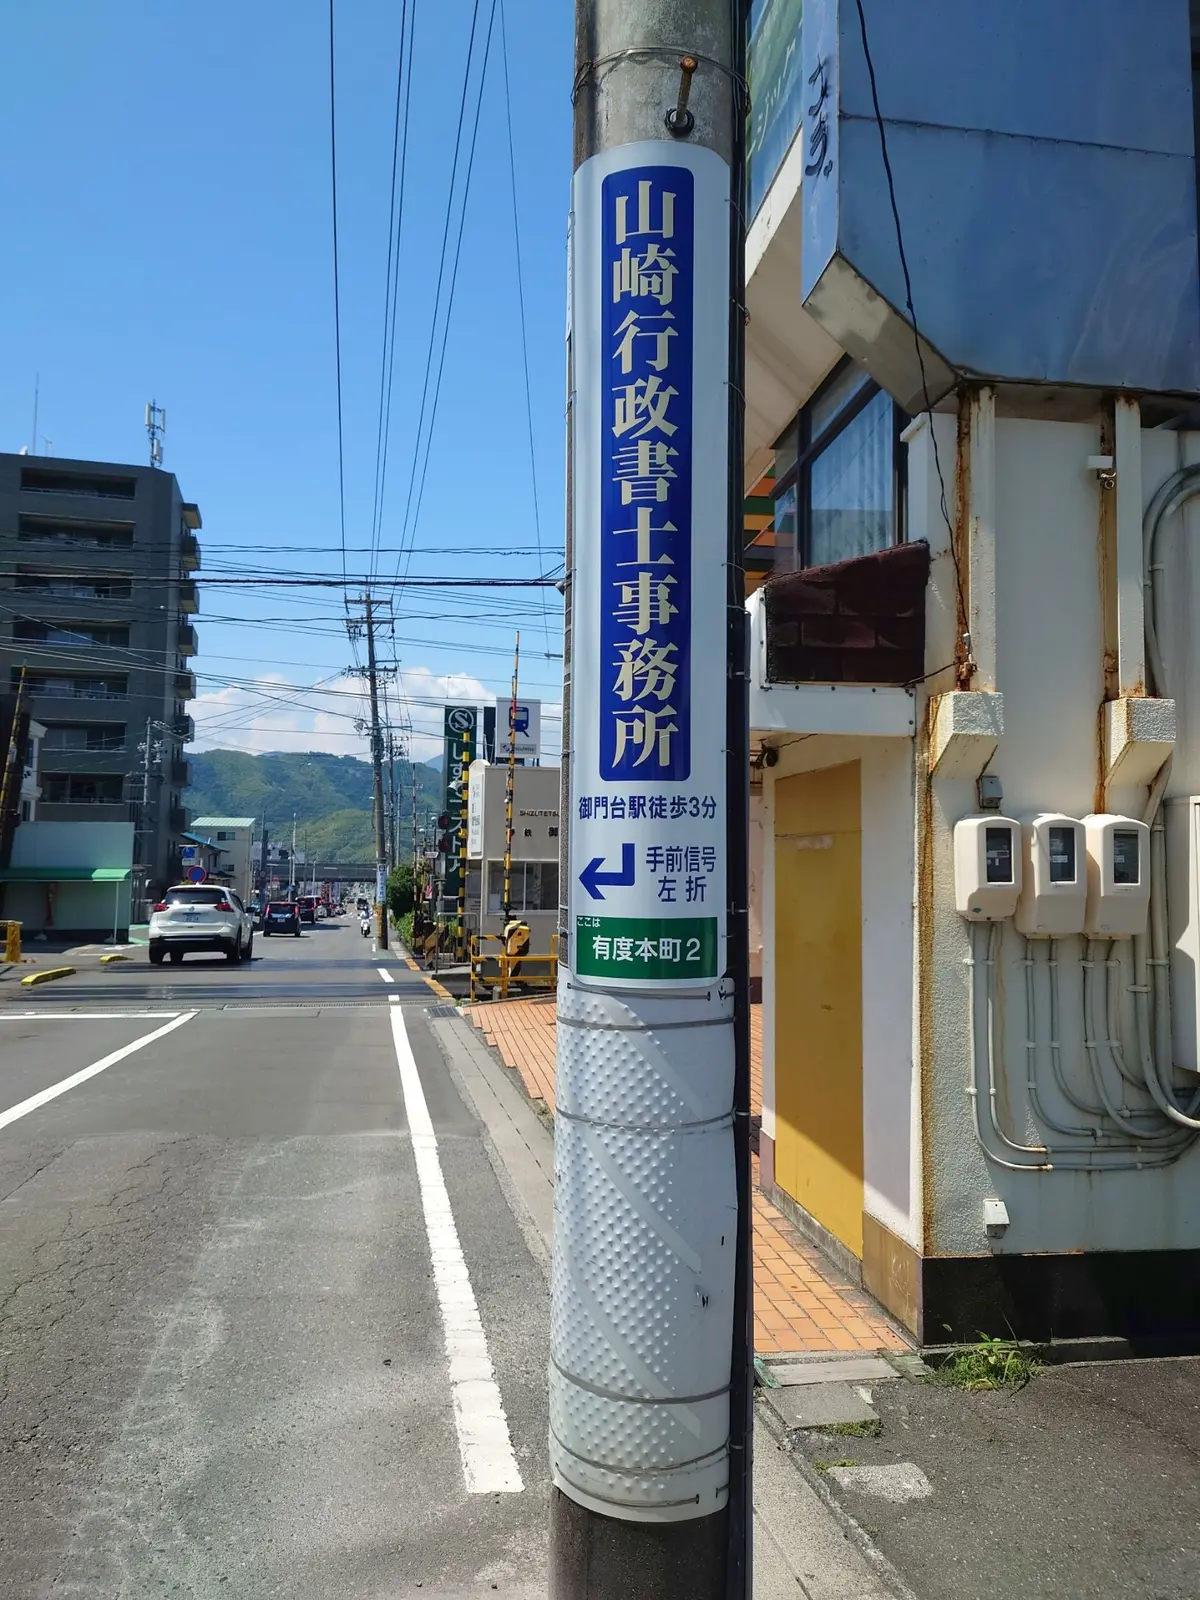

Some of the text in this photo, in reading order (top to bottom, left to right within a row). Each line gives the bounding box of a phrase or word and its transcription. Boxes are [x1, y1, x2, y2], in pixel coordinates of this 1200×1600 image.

[611, 179, 680, 769] 山崎行政書士事務所
[578, 795, 717, 820] 御門台駅徒歩3分
[646, 846, 717, 873] 手前信号
[657, 875, 707, 903] 左折
[577, 916, 601, 928] ここは
[592, 935, 701, 963] 有度本町2
